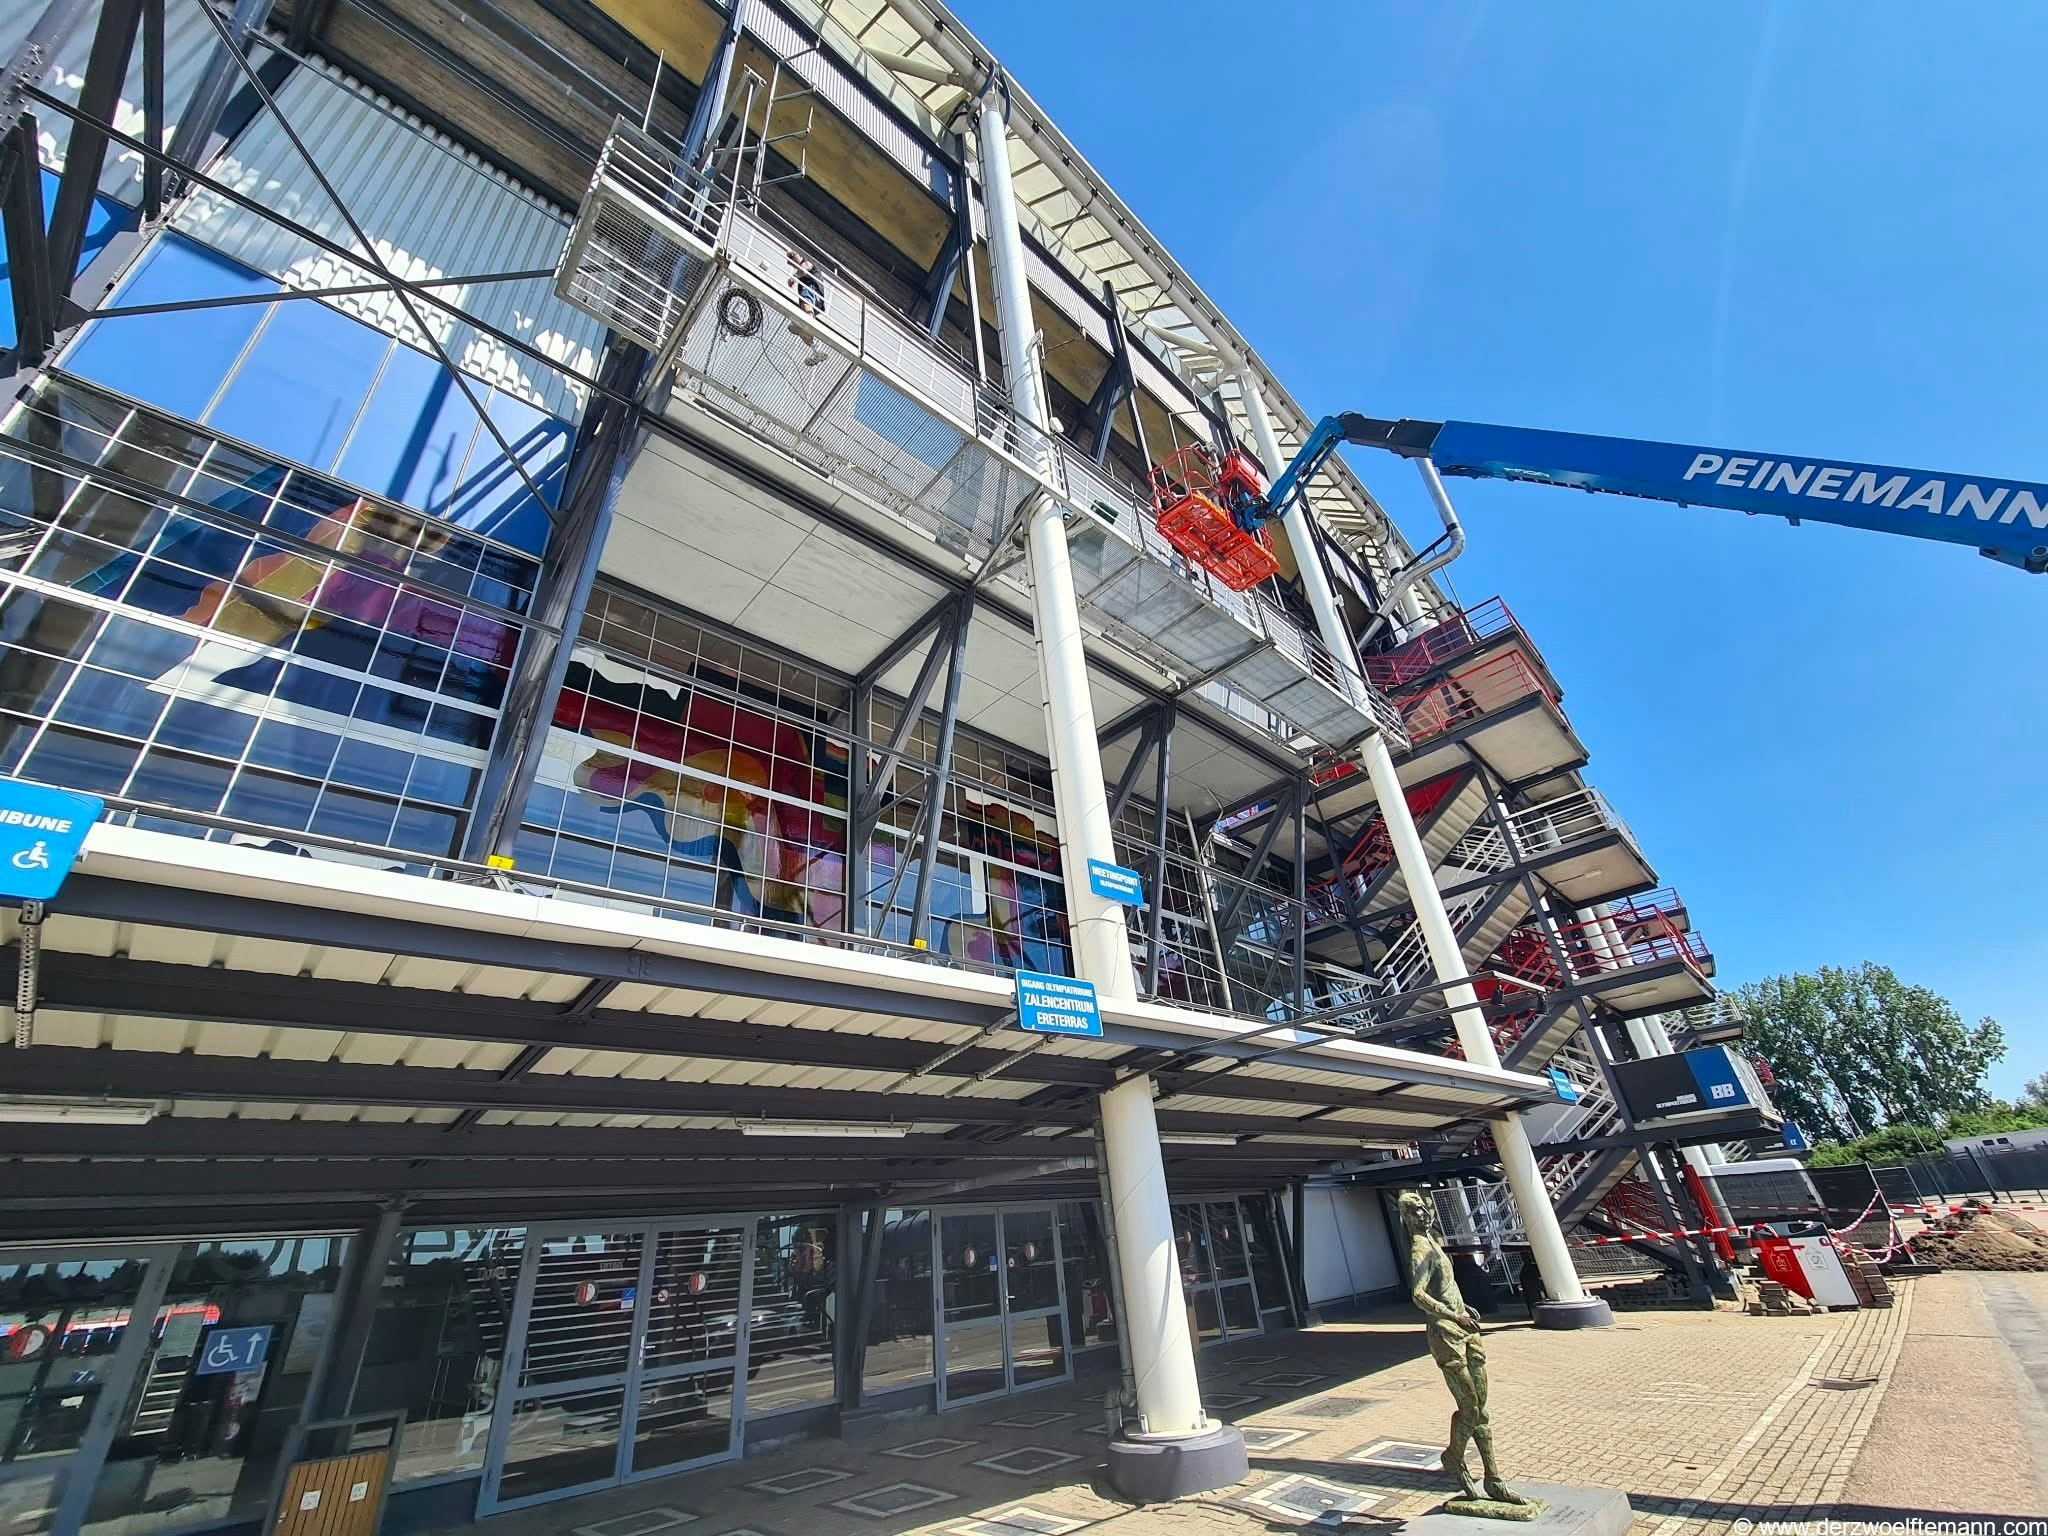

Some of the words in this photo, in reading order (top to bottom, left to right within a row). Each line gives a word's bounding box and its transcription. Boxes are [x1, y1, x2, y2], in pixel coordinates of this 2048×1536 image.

[1683, 453, 2048, 529] PEINEMANN
[0, 810, 72, 833] IBUNE
[1091, 865, 1138, 887] MEETINGPOINT
[1021, 979, 1045, 990] INGANG
[1045, 982, 1094, 998] OLYMPIATRIBUNE
[1024, 992, 1094, 1014] ZALENCENTRUM
[1036, 1011, 1088, 1030] ERETERRAS
[1710, 1083, 1735, 1100] BB
